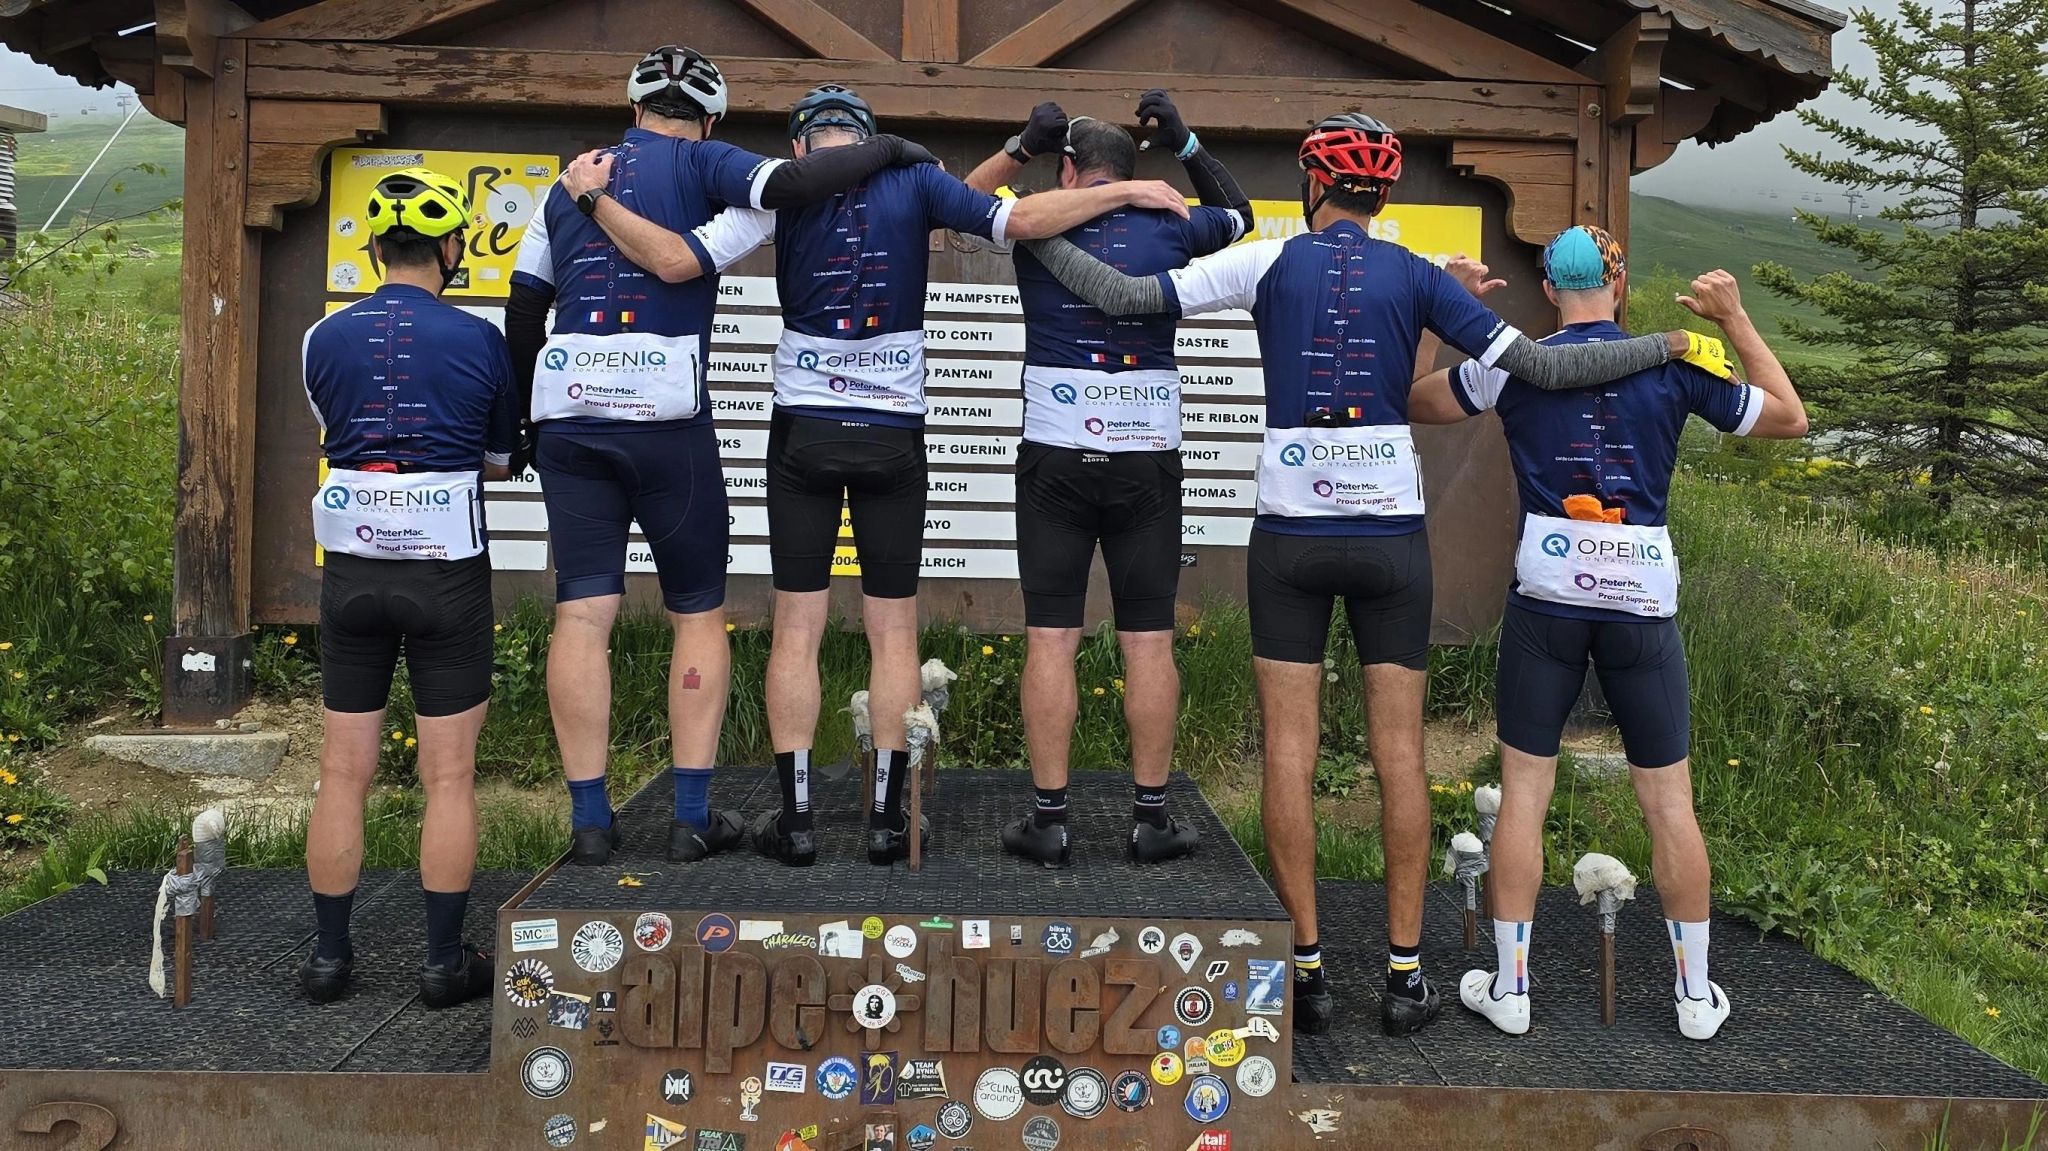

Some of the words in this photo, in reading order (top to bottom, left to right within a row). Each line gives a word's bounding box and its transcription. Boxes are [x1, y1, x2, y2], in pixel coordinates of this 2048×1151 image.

[945, 292, 1019, 304] HAMPSTEN
[950, 331, 992, 341] CONTI
[1177, 337, 1229, 348] SASTRE
[575, 350, 667, 368] OPENIQ
[826, 349, 911, 367] OPENIQ
[707, 361, 768, 373] HINAULT
[934, 368, 992, 379] PANTANI
[1084, 385, 1171, 401] OPENIQ
[584, 400, 611, 408] Proud
[612, 402, 656, 410] Supporter
[635, 409, 656, 417] 2024
[933, 406, 992, 418] PANTANI
[1209, 413, 1259, 424] RIBLON
[1107, 434, 1130, 443] Proud
[1131, 434, 1167, 442] Supporter
[950, 444, 1007, 455] GUERINI
[1151, 441, 1168, 449] 2024
[1180, 450, 1221, 461] PINOT
[1312, 442, 1397, 461] OPENIQ
[355, 489, 451, 507] OPENIQ
[1181, 487, 1237, 498] THOMAS
[1336, 497, 1361, 505] Proud
[1382, 503, 1398, 511] 2024
[376, 543, 401, 552] Proud
[402, 543, 446, 551] Supporter
[1598, 592, 1624, 601] Proud
[1625, 595, 1660, 605] Supporter
[1642, 605, 1660, 613] 2024
[514, 928, 543, 942] SMC
[665, 1078, 690, 1095] MH
[979, 1080, 1020, 1095] CYCLING
[980, 1092, 1016, 1103] around
[699, 1130, 723, 1138] PEAK
